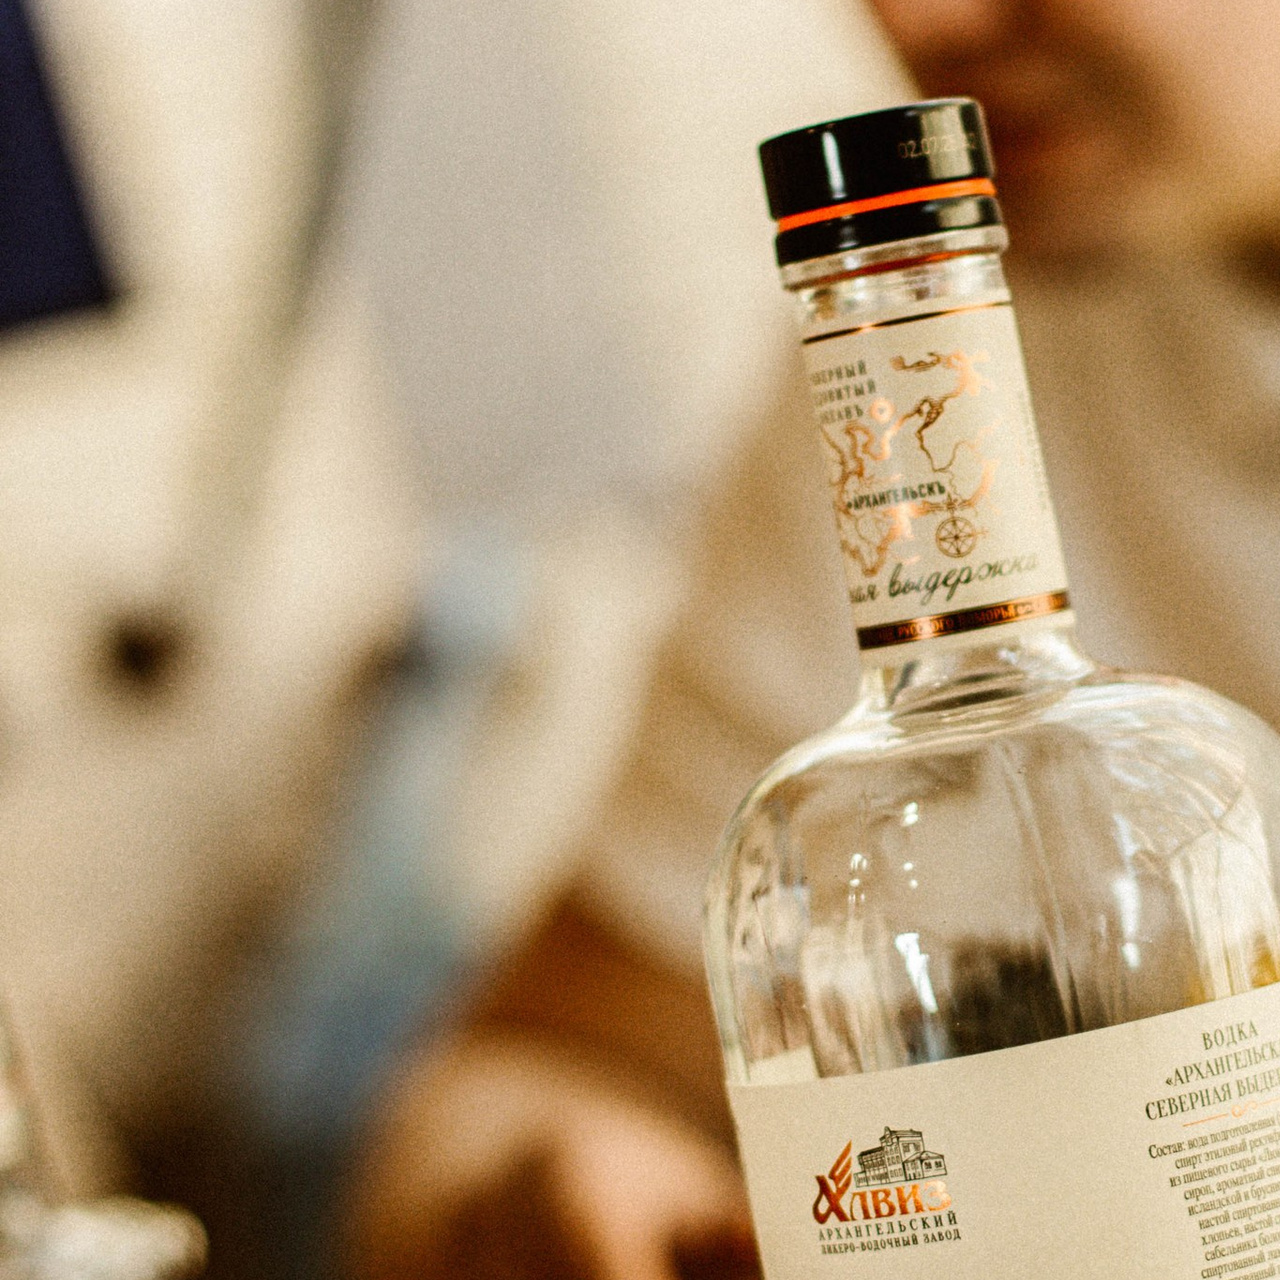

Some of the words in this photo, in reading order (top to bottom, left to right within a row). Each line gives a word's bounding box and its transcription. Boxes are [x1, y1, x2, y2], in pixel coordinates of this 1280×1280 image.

[1202, 1020, 1259, 1051] ВОДКА
[1145, 1082, 1232, 1121] СЕВЕРНАЯ
[1148, 1142, 1186, 1159] Состав:
[1188, 1135, 1209, 1152] вода
[1175, 1155, 1202, 1170] спирт
[1204, 1141, 1248, 1162] этиловый
[1169, 1175, 1182, 1188] из
[1183, 1163, 1229, 1183] пищевого
[1184, 1187, 1216, 1203] сироп,
[818, 1210, 958, 1242] АРХАНГЕЛЬСКИЙ
[1199, 1212, 1231, 1230] настой
[821, 1233, 919, 1255] ЛИКЕРО-ВОДОЧНЫЙ
[924, 1228, 962, 1244] ЗАВОД
